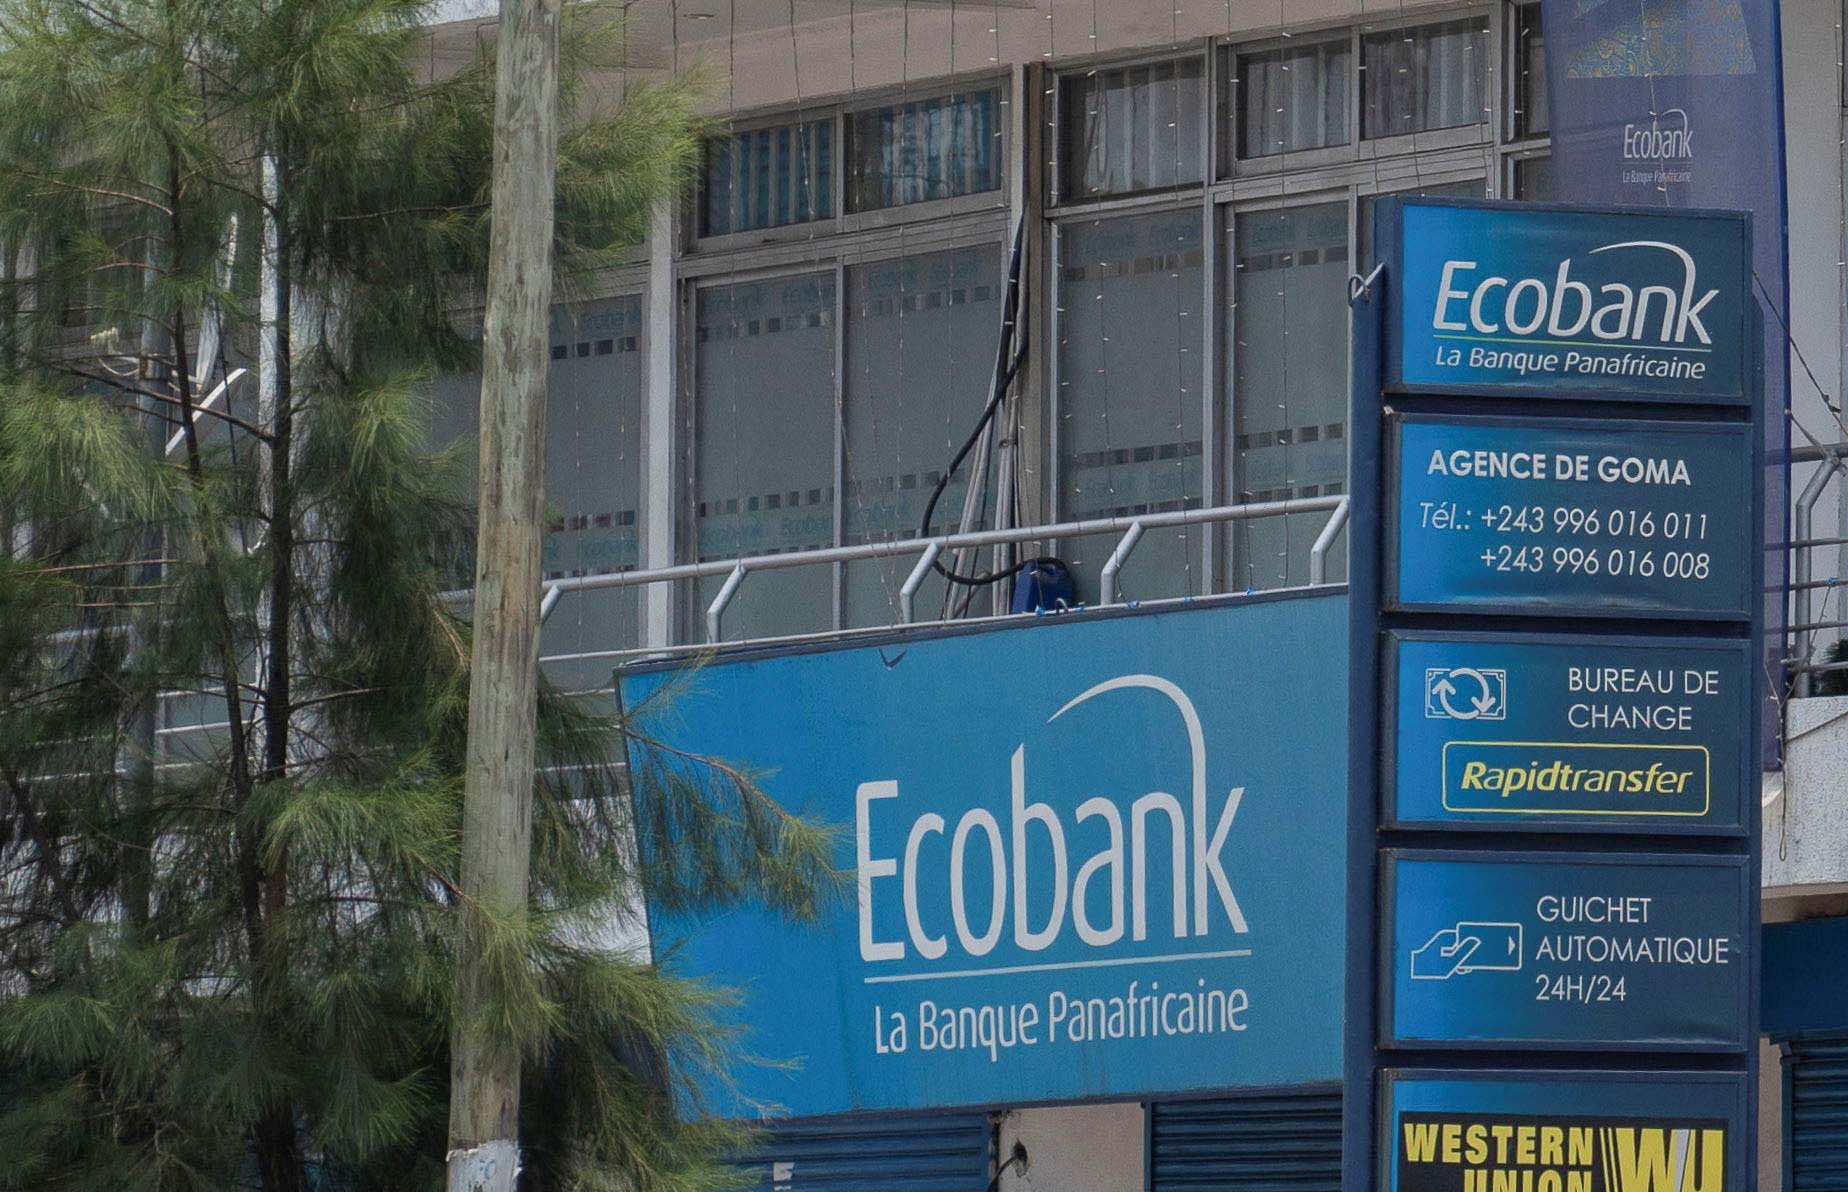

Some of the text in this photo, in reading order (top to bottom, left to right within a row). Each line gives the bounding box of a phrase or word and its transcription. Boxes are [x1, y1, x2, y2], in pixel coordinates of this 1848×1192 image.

[1624, 108, 1693, 159] Ecobank
[1432, 240, 1720, 345] Ecobank
[1436, 345, 1706, 380] La Banque Panafricaine
[1427, 449, 1691, 486] AGENCE DE GOMA
[1420, 501, 1708, 540] Tél.: +243 996 016 011
[1480, 545, 1710, 579] +243 996 016 008
[1568, 668, 1719, 695] BUREAU DE
[1567, 703, 1693, 732] CHANGE
[1460, 760, 1693, 798] Rapidtransfer
[856, 673, 1249, 962] Ecobank
[1536, 896, 1652, 923] GUICHET
[1535, 936, 1730, 966] AUTOMATIQUE
[1535, 974, 1627, 1004] 24H/24
[875, 978, 1249, 1063] La Banque Panafricaine
[1404, 1123, 1594, 1166] WESTERN
